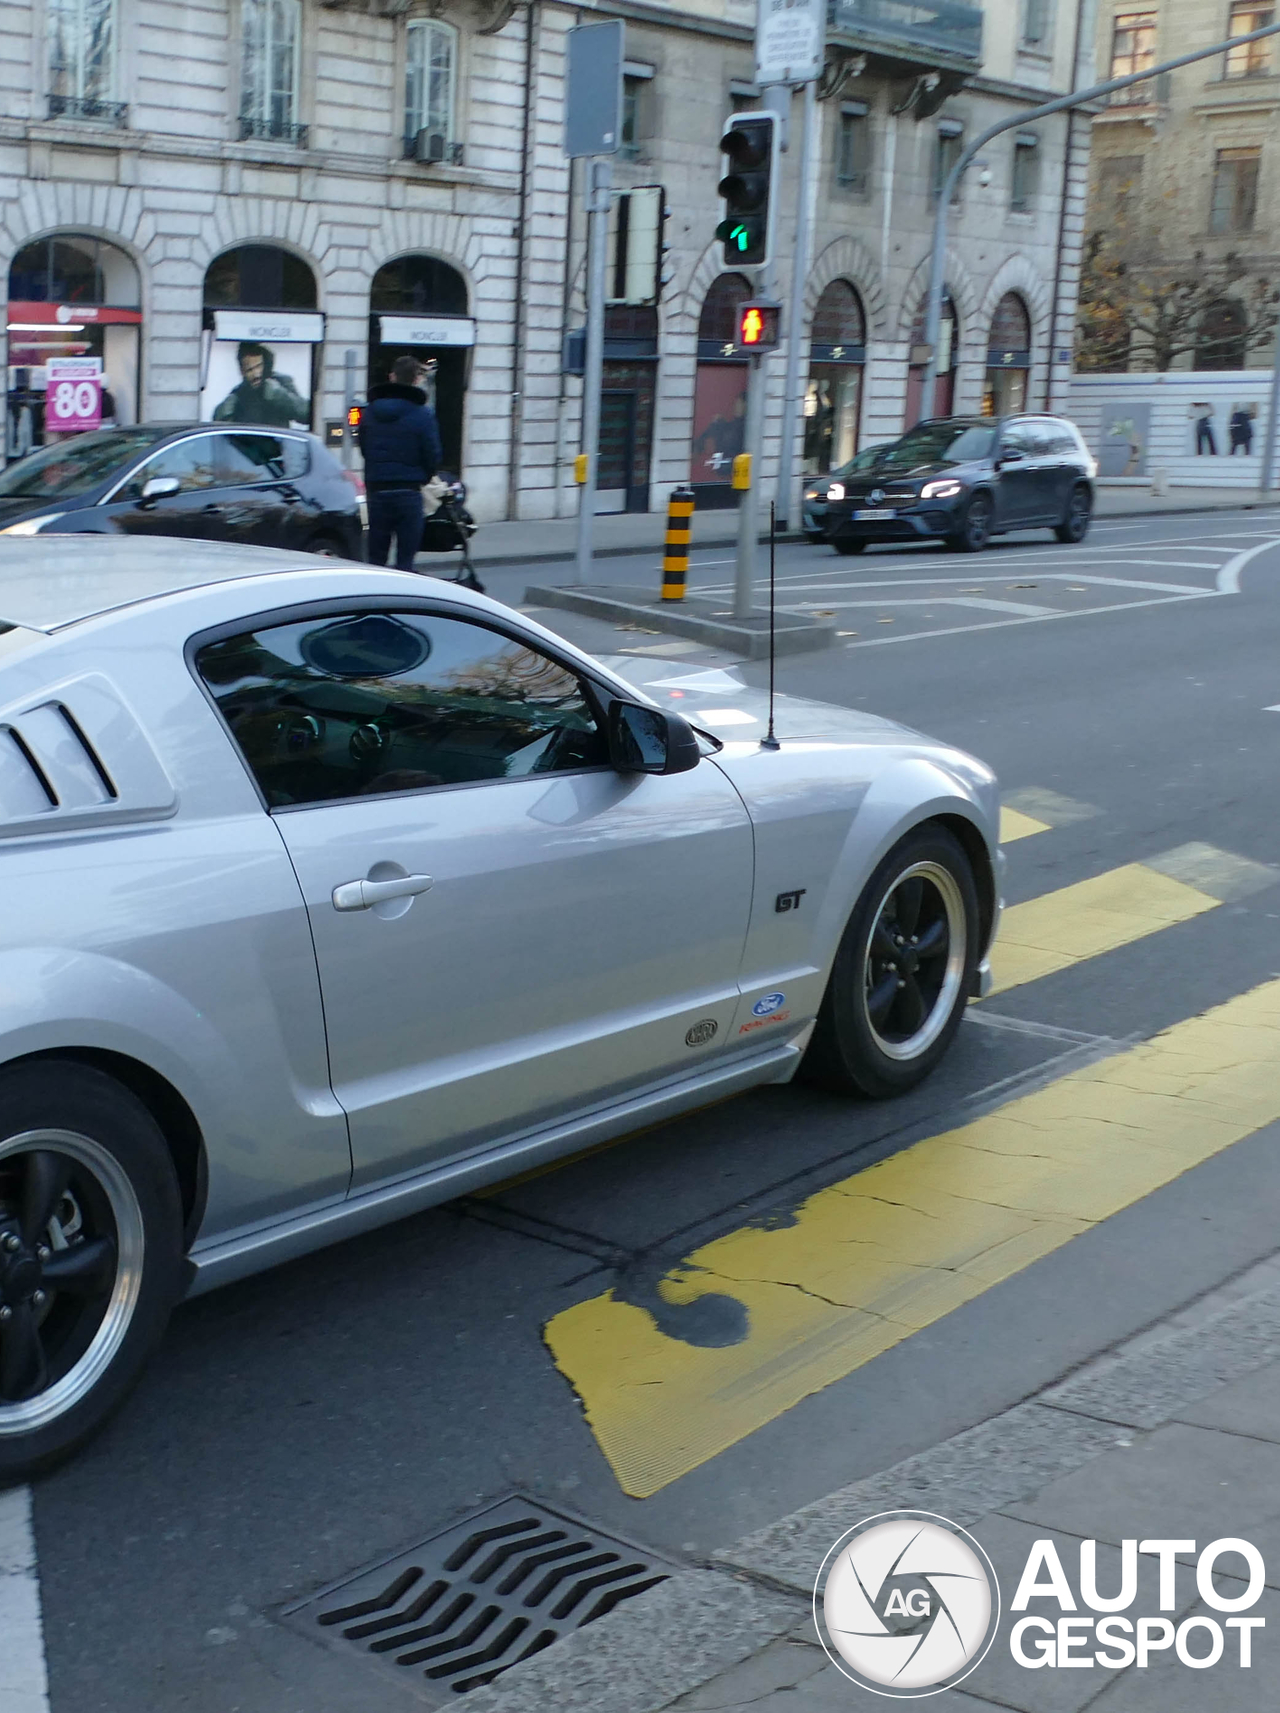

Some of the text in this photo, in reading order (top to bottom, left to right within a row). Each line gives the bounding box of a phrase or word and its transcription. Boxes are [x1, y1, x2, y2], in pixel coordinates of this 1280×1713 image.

[248, 327, 292, 338] MONCLER
[775, 888, 807, 913] GT
[739, 1010, 791, 1035] RACING
